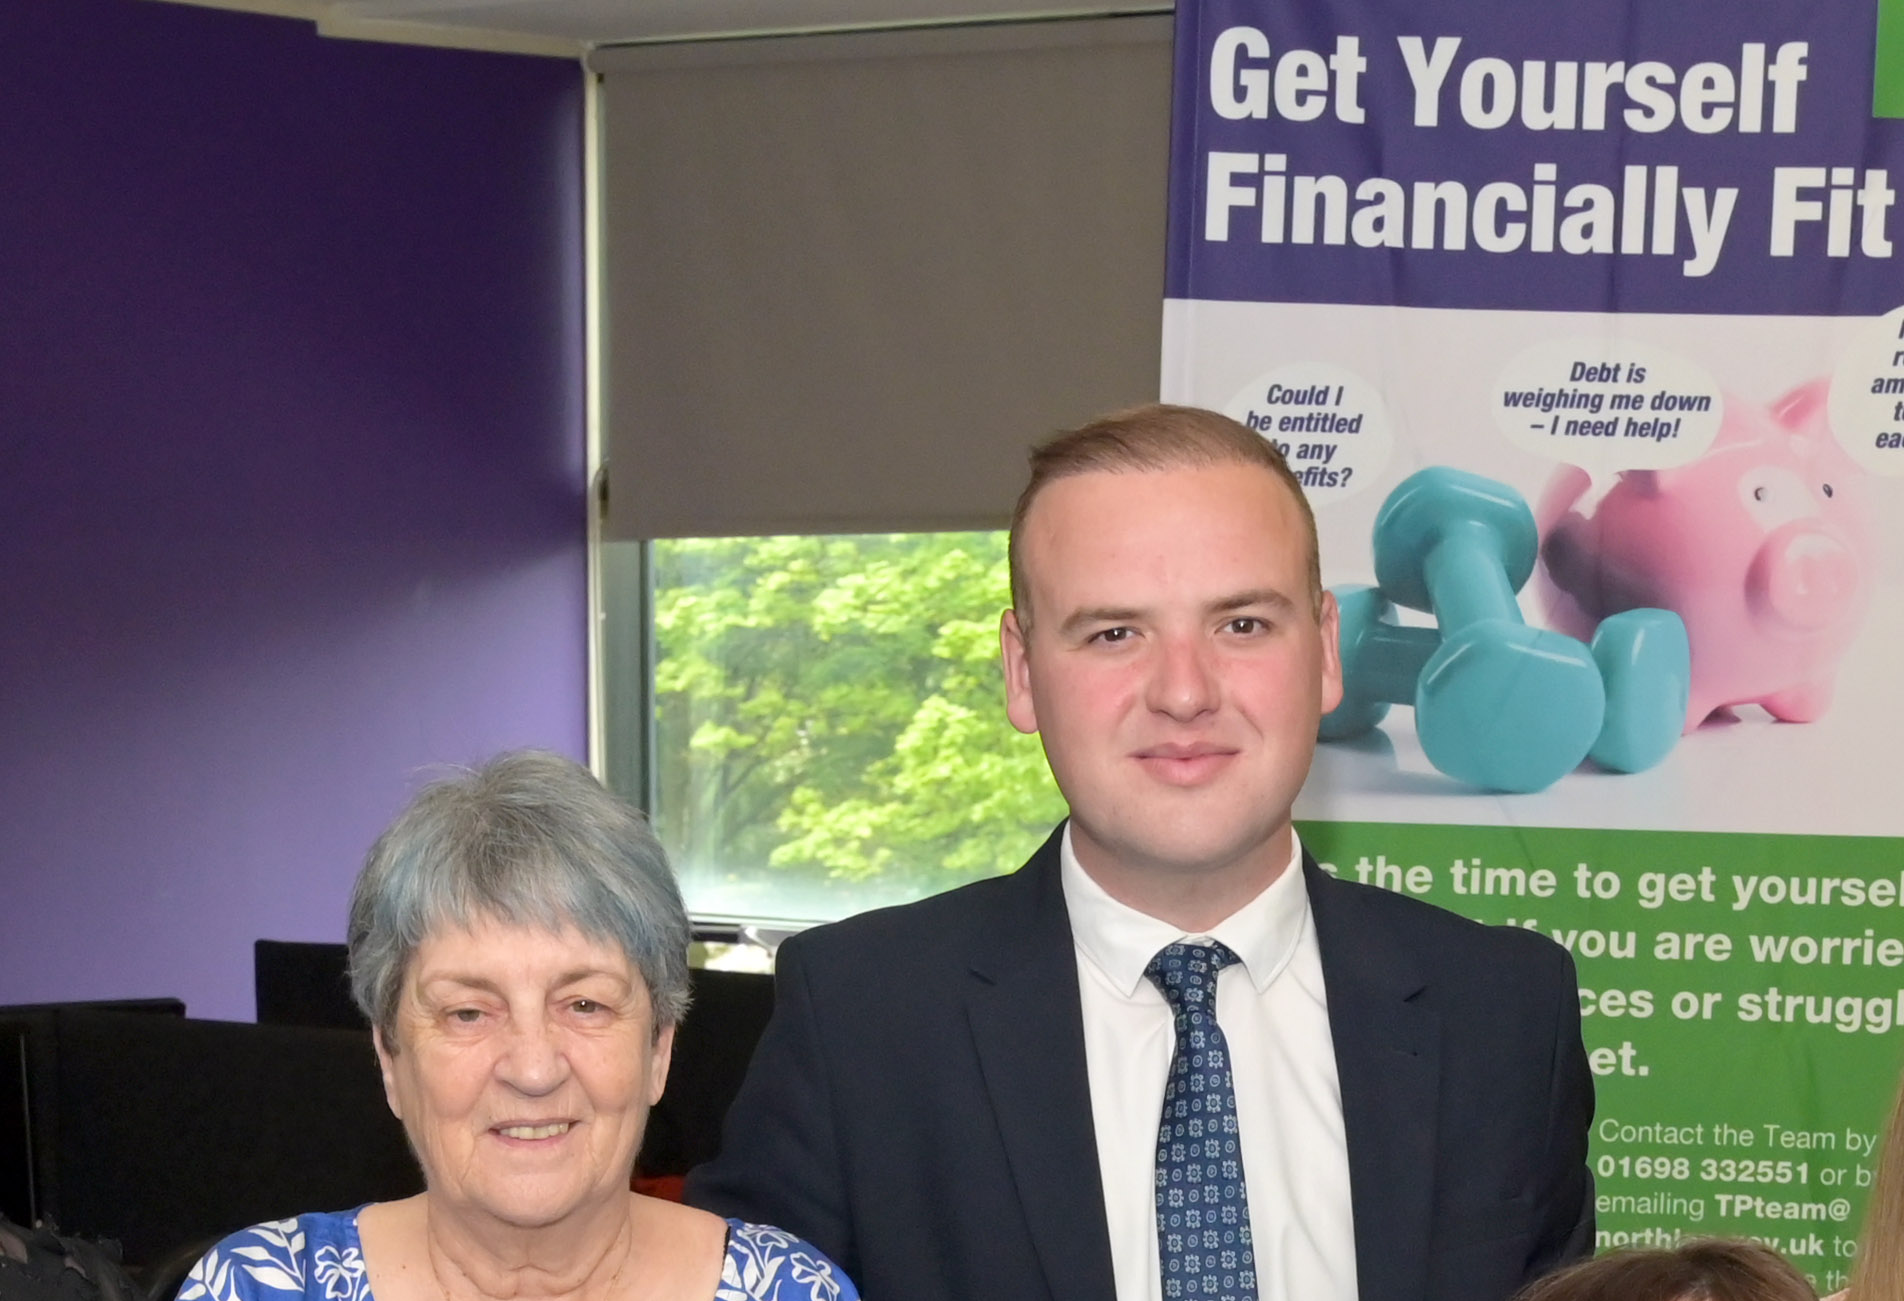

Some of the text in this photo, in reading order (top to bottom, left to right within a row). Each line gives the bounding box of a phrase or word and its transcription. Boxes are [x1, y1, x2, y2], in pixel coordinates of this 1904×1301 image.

[1209, 26, 1809, 134] Get Yourself
[1202, 151, 1895, 277] Financially Fit
[1570, 362, 1646, 383] Debt is
[1267, 384, 1344, 406] Could I
[1503, 389, 1711, 413] weighing me down
[1246, 410, 1363, 433] be entitled
[1550, 417, 1681, 442] I need help!
[1296, 443, 1337, 464] any
[1355, 855, 1434, 894] the
[1450, 858, 1558, 896] time
[1574, 863, 1621, 899] to
[1637, 866, 1716, 909] get
[1552, 929, 1636, 958] you
[1653, 931, 1732, 961] are
[1671, 990, 1722, 1020] or
[1599, 1118, 1877, 1157] Contact the Team by
[1597, 1155, 1848, 1186] 01698 332551 or
[1596, 1193, 1850, 1222] emailing TPteam@
